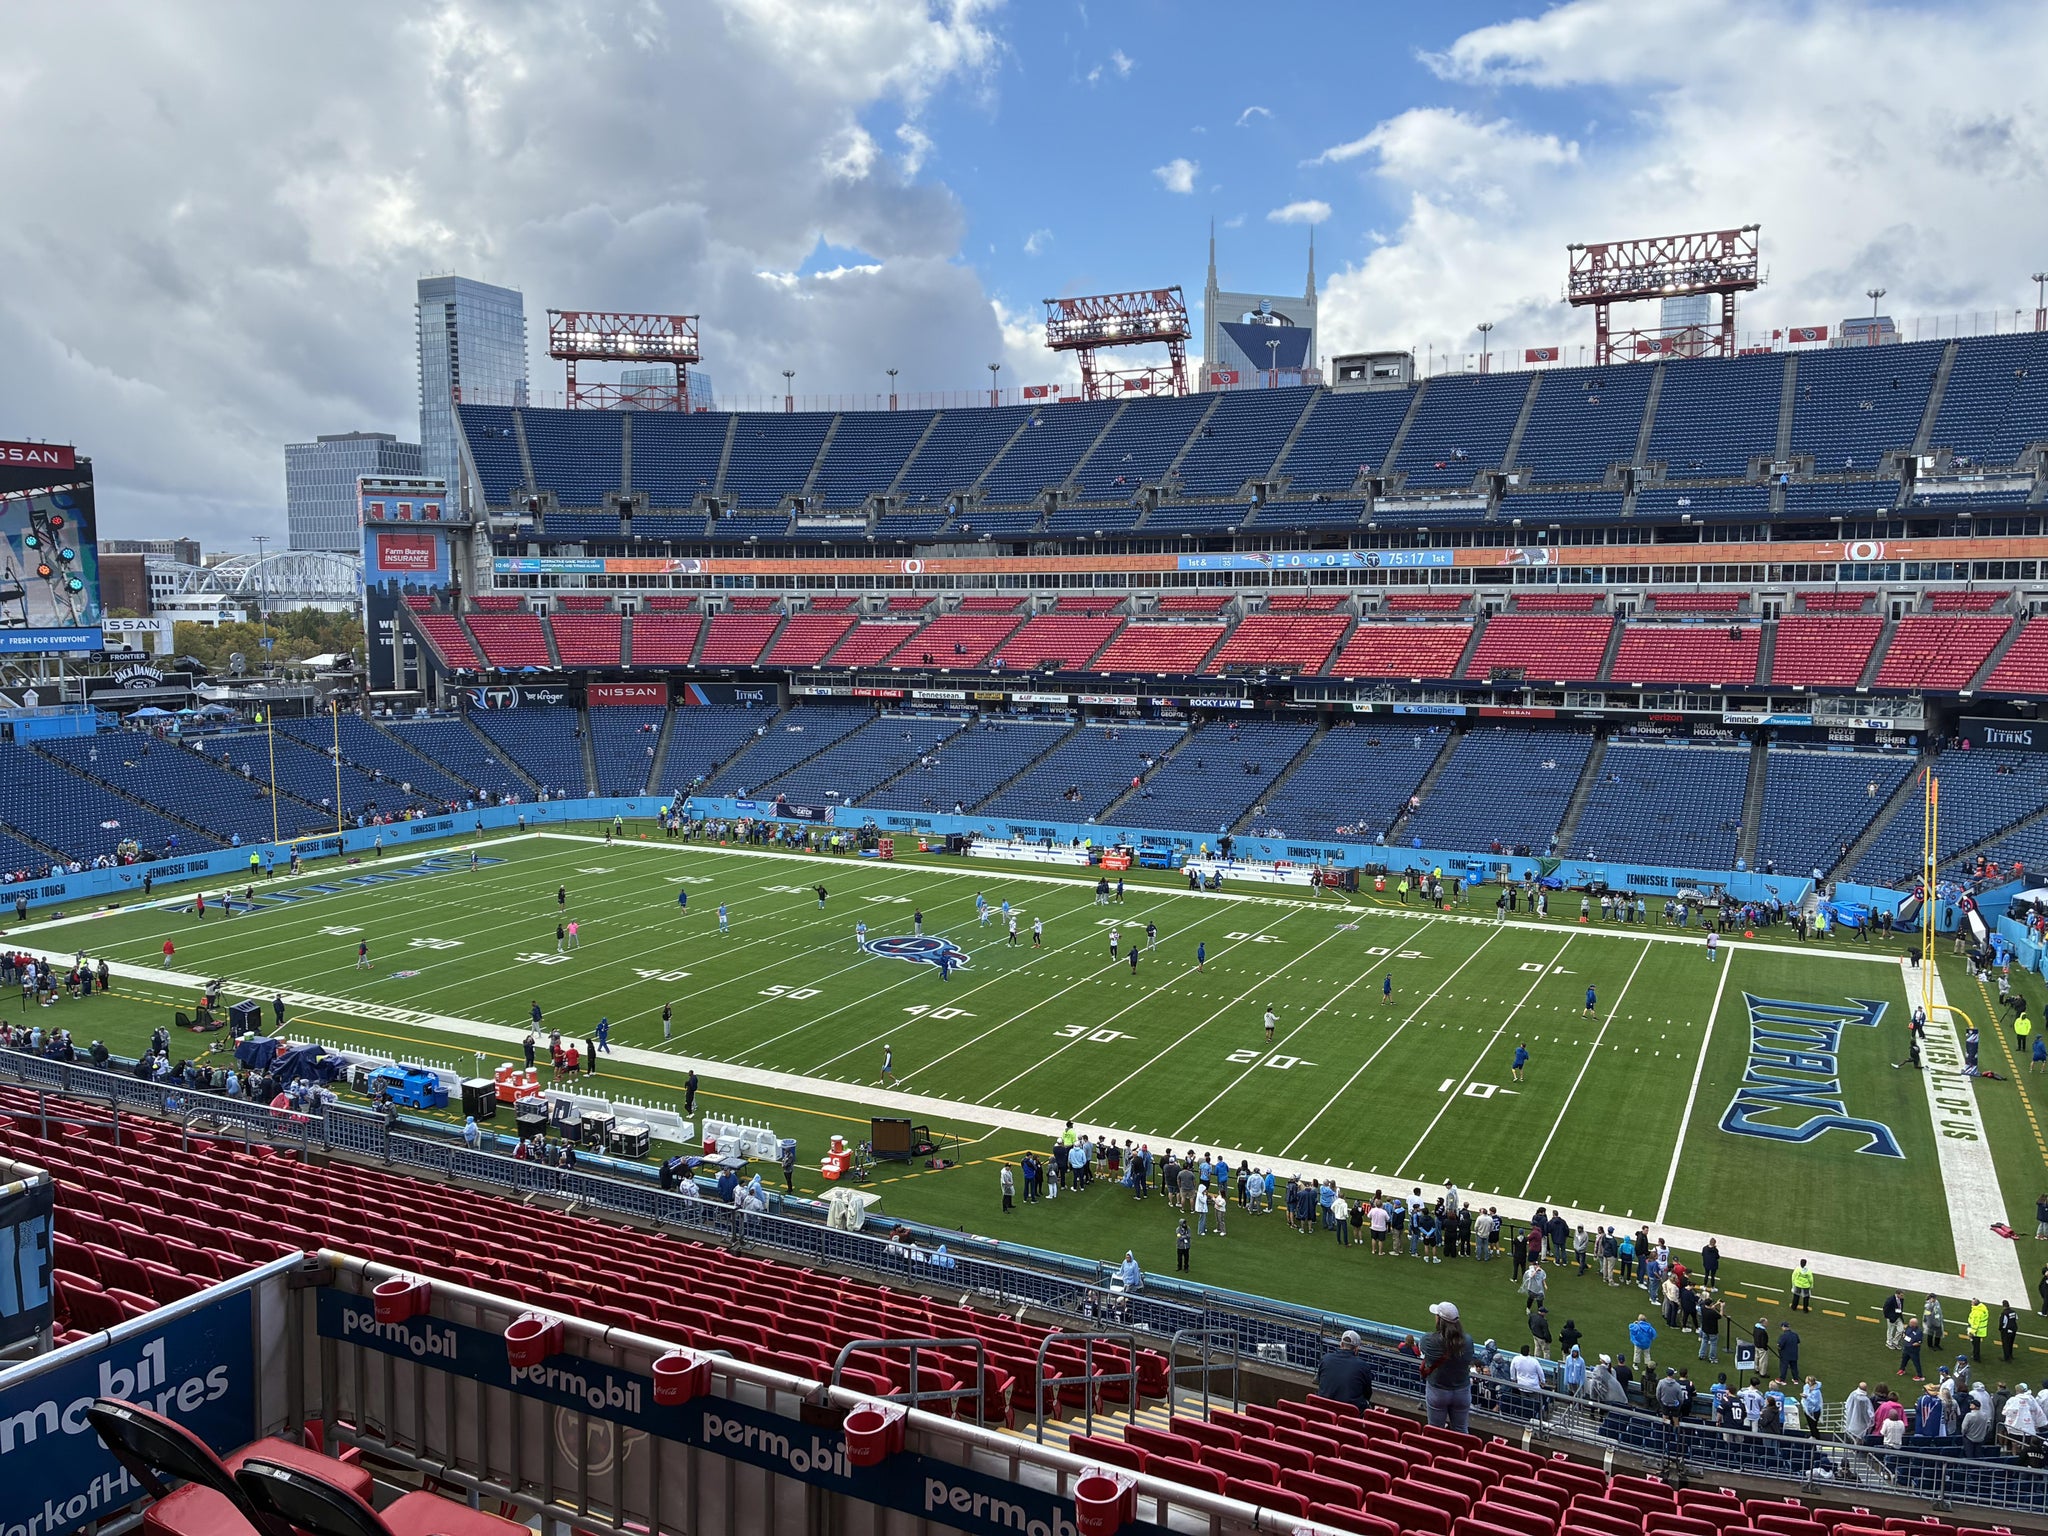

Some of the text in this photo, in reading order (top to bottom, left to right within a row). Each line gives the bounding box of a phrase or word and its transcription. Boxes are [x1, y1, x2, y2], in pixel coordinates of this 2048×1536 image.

[385, 547, 403, 555] Farm
[1292, 556, 1300, 566] 0
[1326, 555, 1335, 565] 0
[1389, 553, 1425, 565] 75:17
[1432, 554, 1445, 563] 1st
[104, 620, 160, 630] ISSAN
[9, 636, 31, 644] FRESH
[110, 652, 146, 661] FRONTIER
[114, 664, 165, 684] JACK DANIEL'S
[536, 689, 564, 704] Kroger
[598, 688, 657, 697] NISSAN
[734, 689, 763, 701] TITANS
[1190, 699, 1218, 707] ROCKY
[1417, 706, 1456, 714] Gallagher
[1648, 713, 1683, 722] verizon
[1723, 714, 1759, 724] Pinnacle
[1864, 720, 1889, 729] tsu
[1828, 734, 1856, 742] REESE
[1875, 736, 1906, 744] FISHER
[1984, 727, 2033, 745] TITANS
[411, 823, 437, 835] TENNESSEE
[1008, 825, 1057, 837] TENNESSEE TOUGH
[321, 838, 343, 850] TOUG
[1141, 835, 1172, 846] TENNESSEE
[1287, 846, 1322, 858] TENNESSEE
[187, 859, 209, 872] TOUGH
[1626, 874, 1698, 889] TENNESSEE TOUGH
[0, 883, 66, 902] ENNESSEE TOUGH
[414, 937, 466, 950] 20
[516, 952, 574, 965] 30
[634, 968, 693, 982] 40
[758, 983, 824, 1000] 50
[902, 1003, 965, 1021] 40
[1053, 1023, 1124, 1043] 30
[1923, 1033, 1960, 1067] TAKES
[1224, 1048, 1303, 1070] 20
[1717, 990, 1907, 1160] TITANS
[1930, 1067, 1967, 1092] ALL
[1437, 1077, 1500, 1099] 10
[513, 1090, 522, 1100] G
[1935, 1097, 1973, 1117] OF
[1940, 1120, 1979, 1141] US
[831, 1157, 840, 1168] G
[342, 1307, 457, 1360] permobil
[1742, 1350, 1751, 1361] D
[510, 1363, 642, 1414] permobil
[1731, 1407, 1742, 1420] 10
[702, 1411, 852, 1478] permobil
[924, 1476, 1082, 1536] permob
